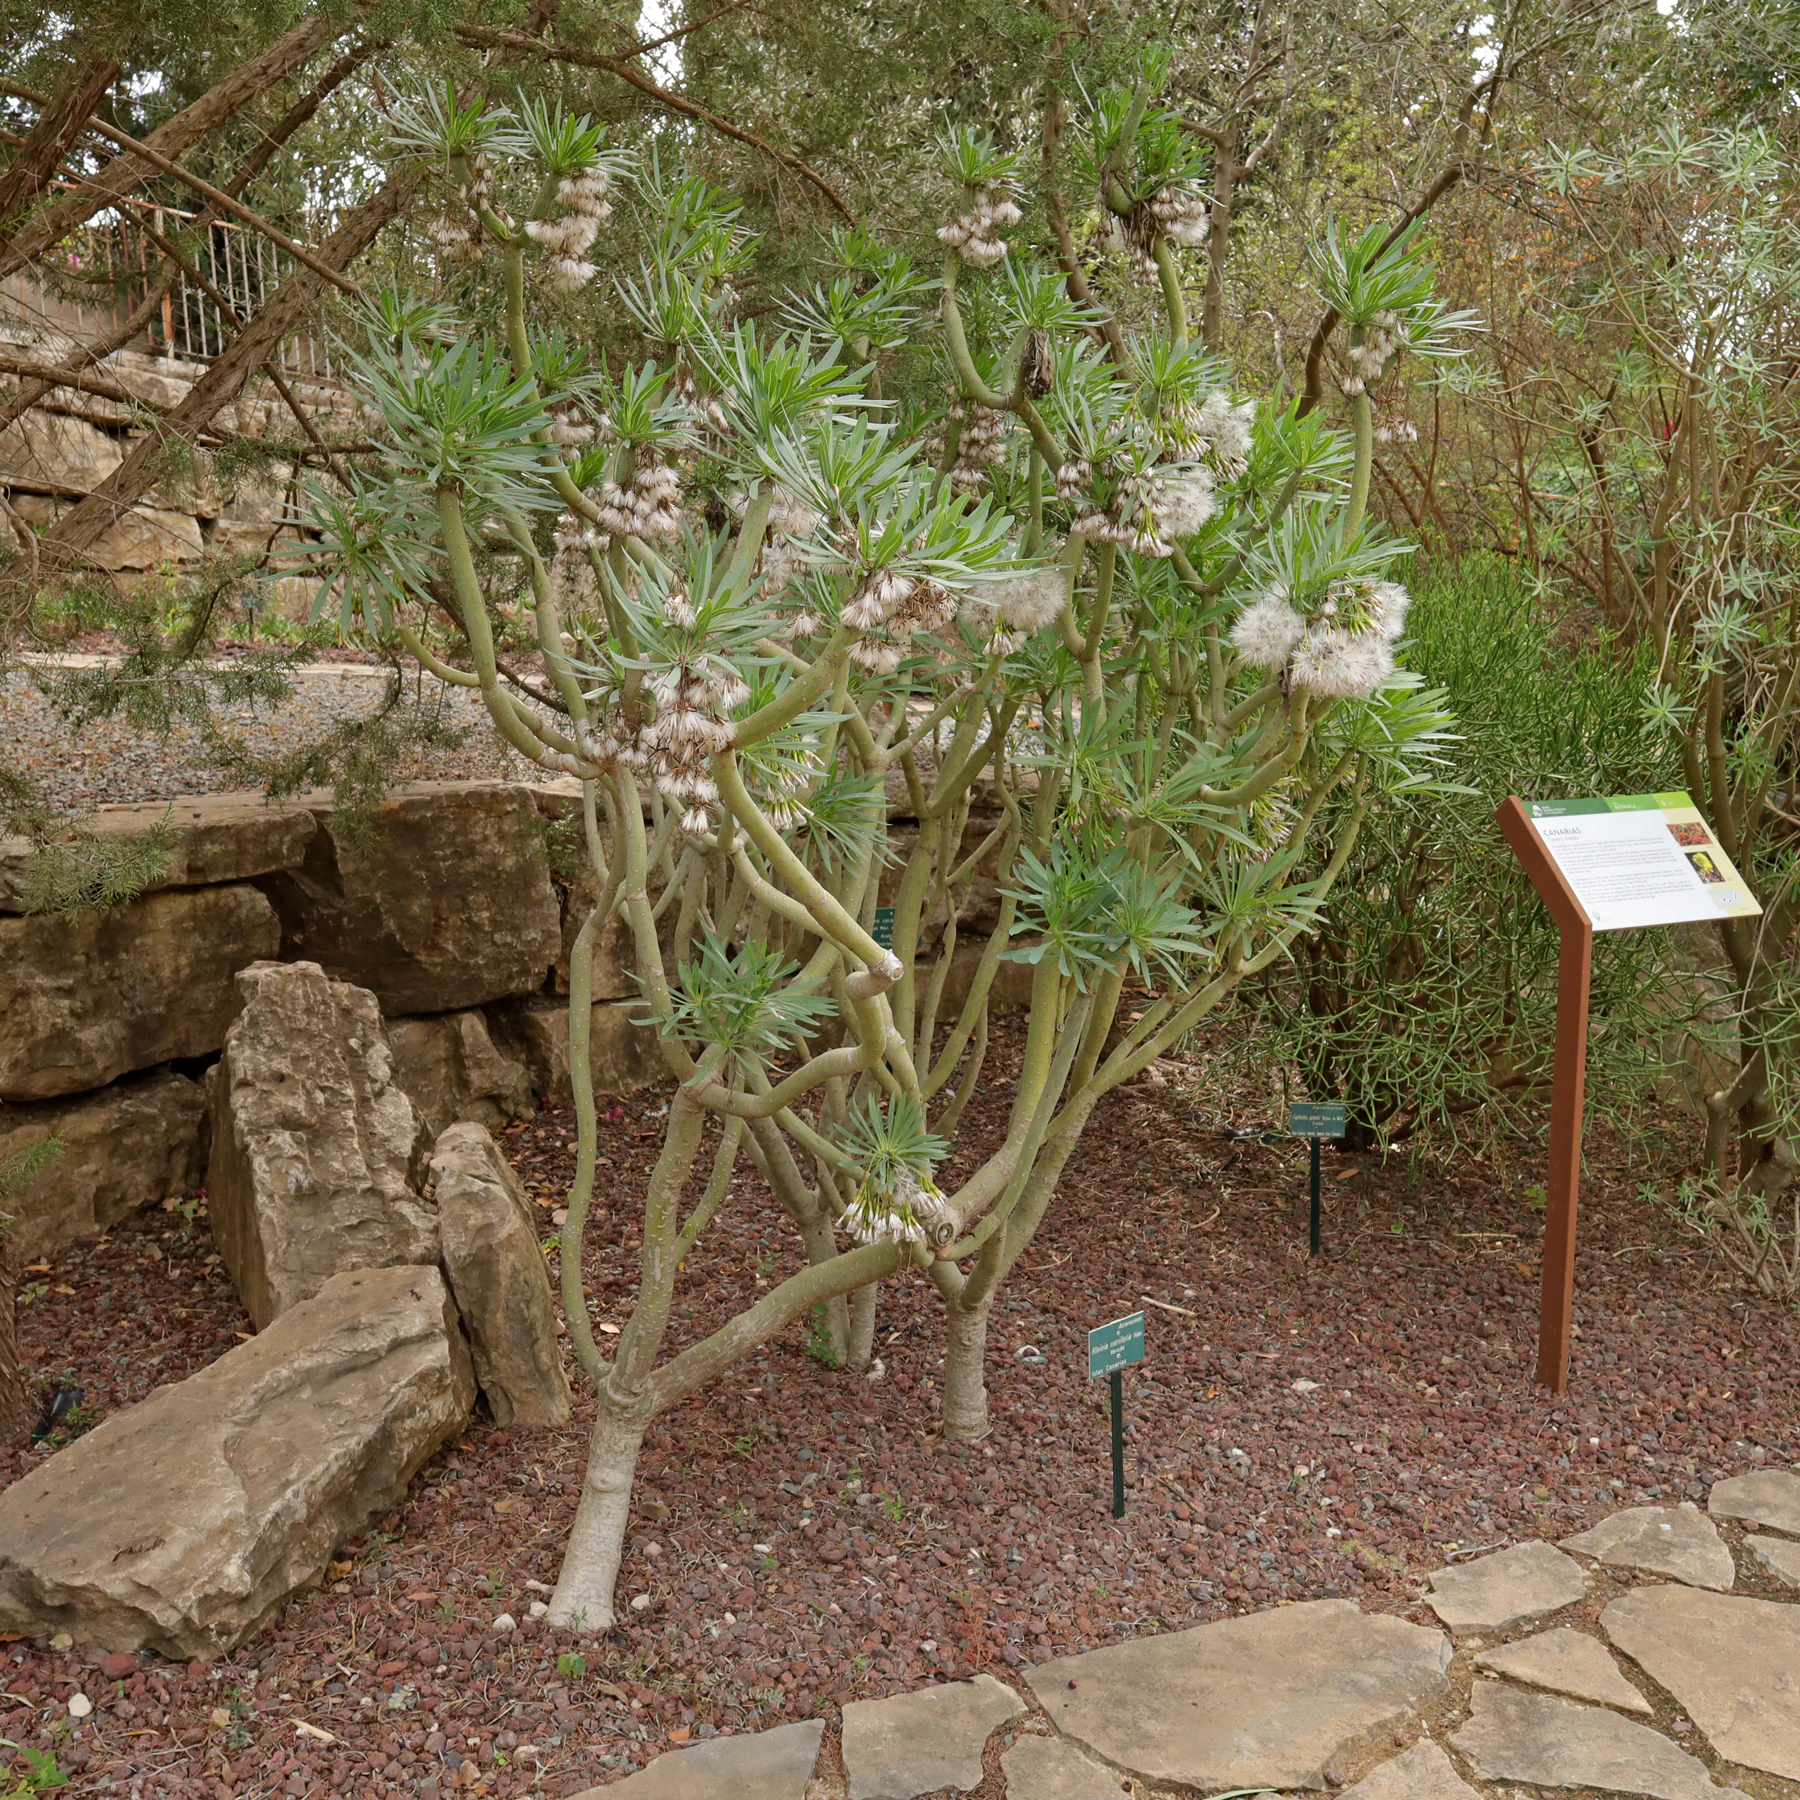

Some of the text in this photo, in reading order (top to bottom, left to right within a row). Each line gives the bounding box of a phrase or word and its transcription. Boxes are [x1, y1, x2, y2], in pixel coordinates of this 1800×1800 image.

[1543, 828, 1582, 836] CANARIAS
[1092, 1359, 1127, 1377] Islas Canarias
